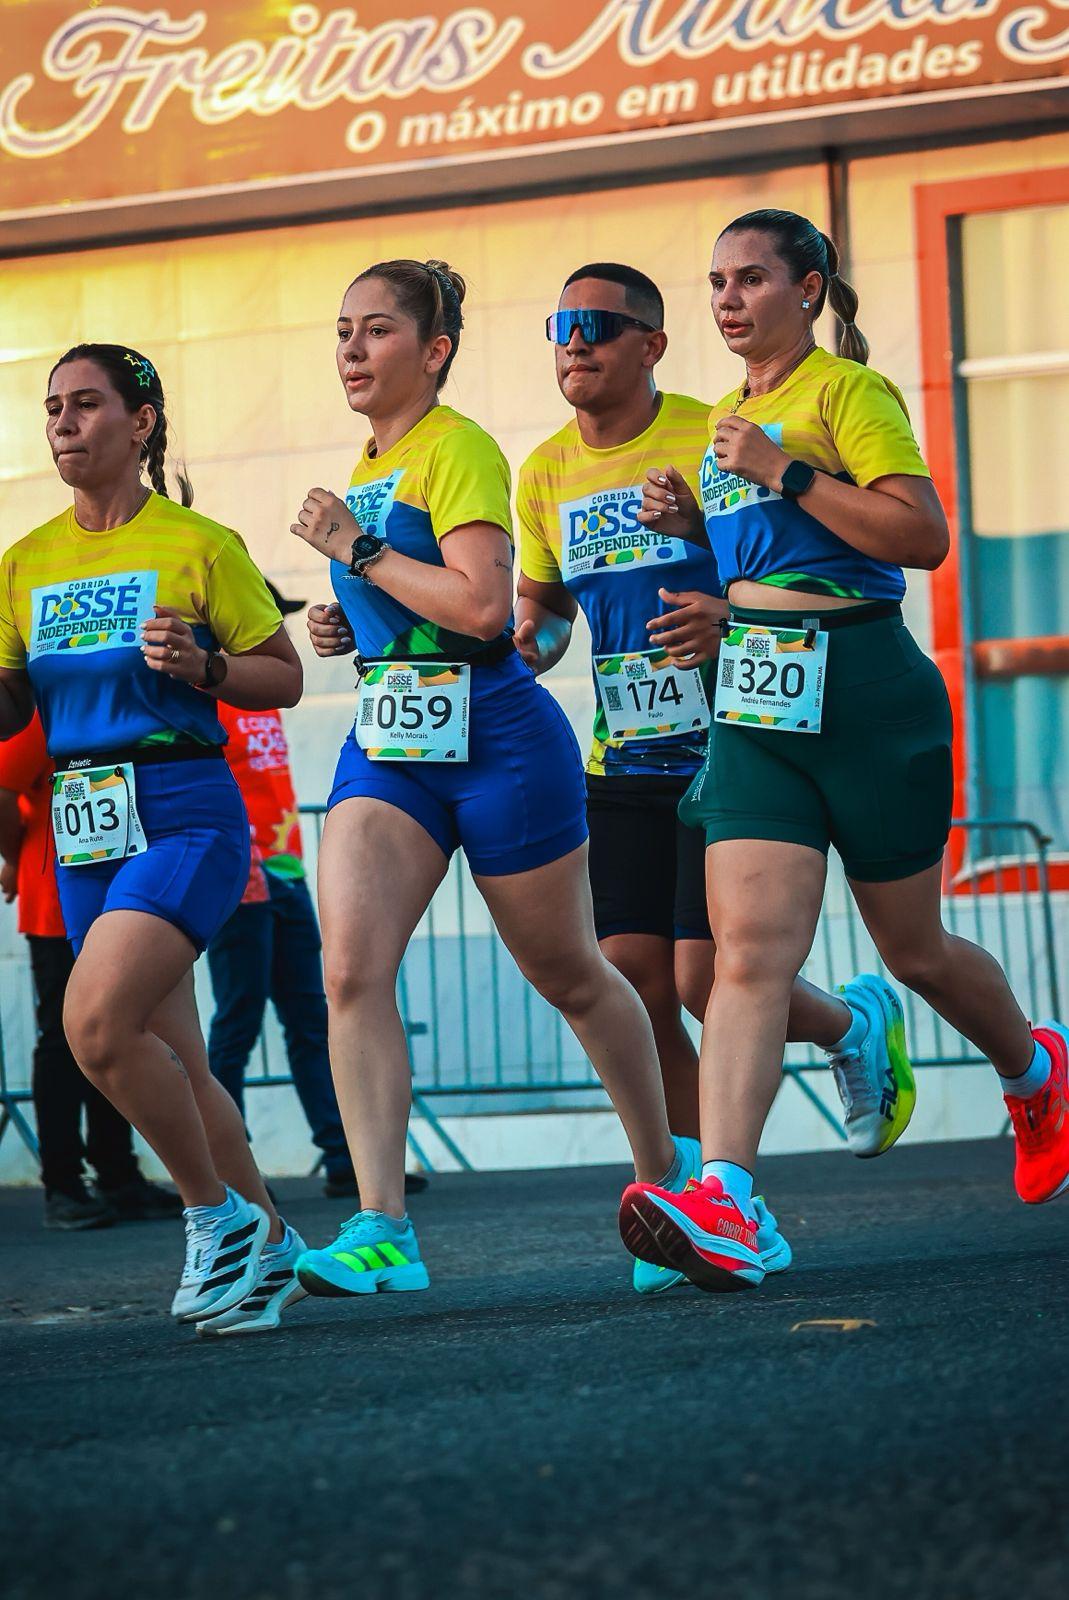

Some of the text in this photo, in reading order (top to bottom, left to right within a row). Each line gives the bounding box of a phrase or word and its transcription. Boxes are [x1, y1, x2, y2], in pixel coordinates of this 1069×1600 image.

[1, 4, 526, 159] Freitas
[396, 89, 604, 148] máximo
[616, 77, 698, 119] em
[711, 34, 983, 107] utilidades
[592, 490, 636, 504] CORRIDA
[568, 500, 643, 547] DISS
[568, 533, 672, 562] INDEPENDENTE
[68, 578, 111, 591] CORRIDA
[37, 617, 137, 642] INDEPENDENTE
[626, 675, 684, 712] 174
[737, 657, 806, 699] 320
[377, 694, 453, 730] 059
[759, 698, 792, 708] Fernandes
[389, 732, 429, 740] Kelly Morais
[64, 798, 120, 836] 013
